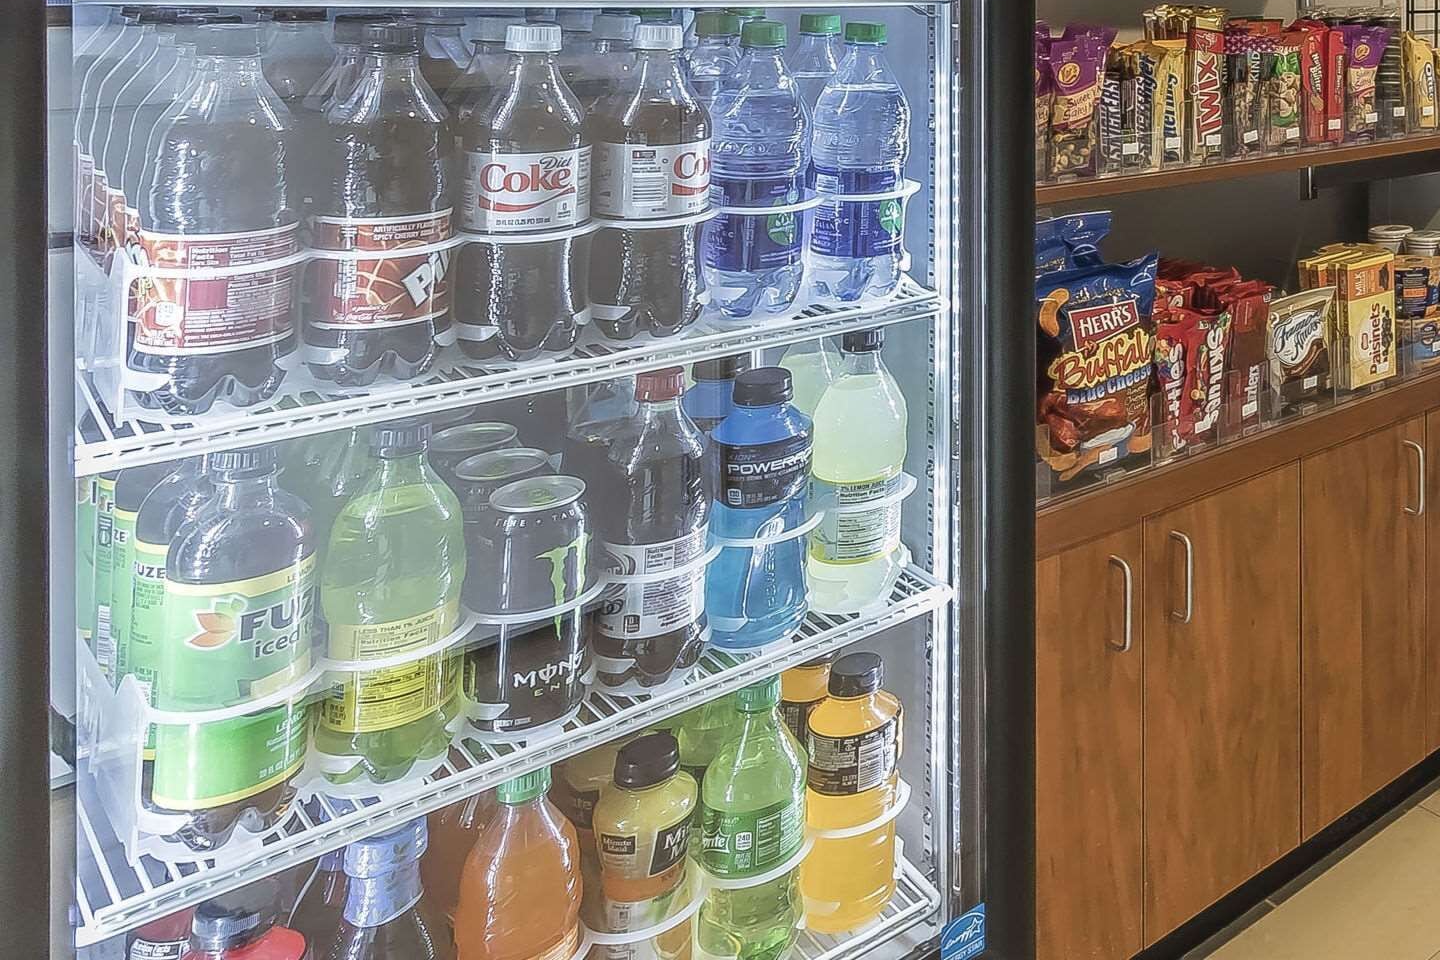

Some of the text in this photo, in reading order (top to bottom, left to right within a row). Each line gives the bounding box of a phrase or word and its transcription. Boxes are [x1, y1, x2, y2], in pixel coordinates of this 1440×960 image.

[539, 155, 573, 170] Diet
[479, 162, 574, 194] Coke
[373, 233, 393, 241] SPICY
[1077, 304, 1134, 339] HERR'S
[134, 561, 166, 580] UZE
[240, 586, 313, 641] FUZ
[254, 629, 300, 659] iced
